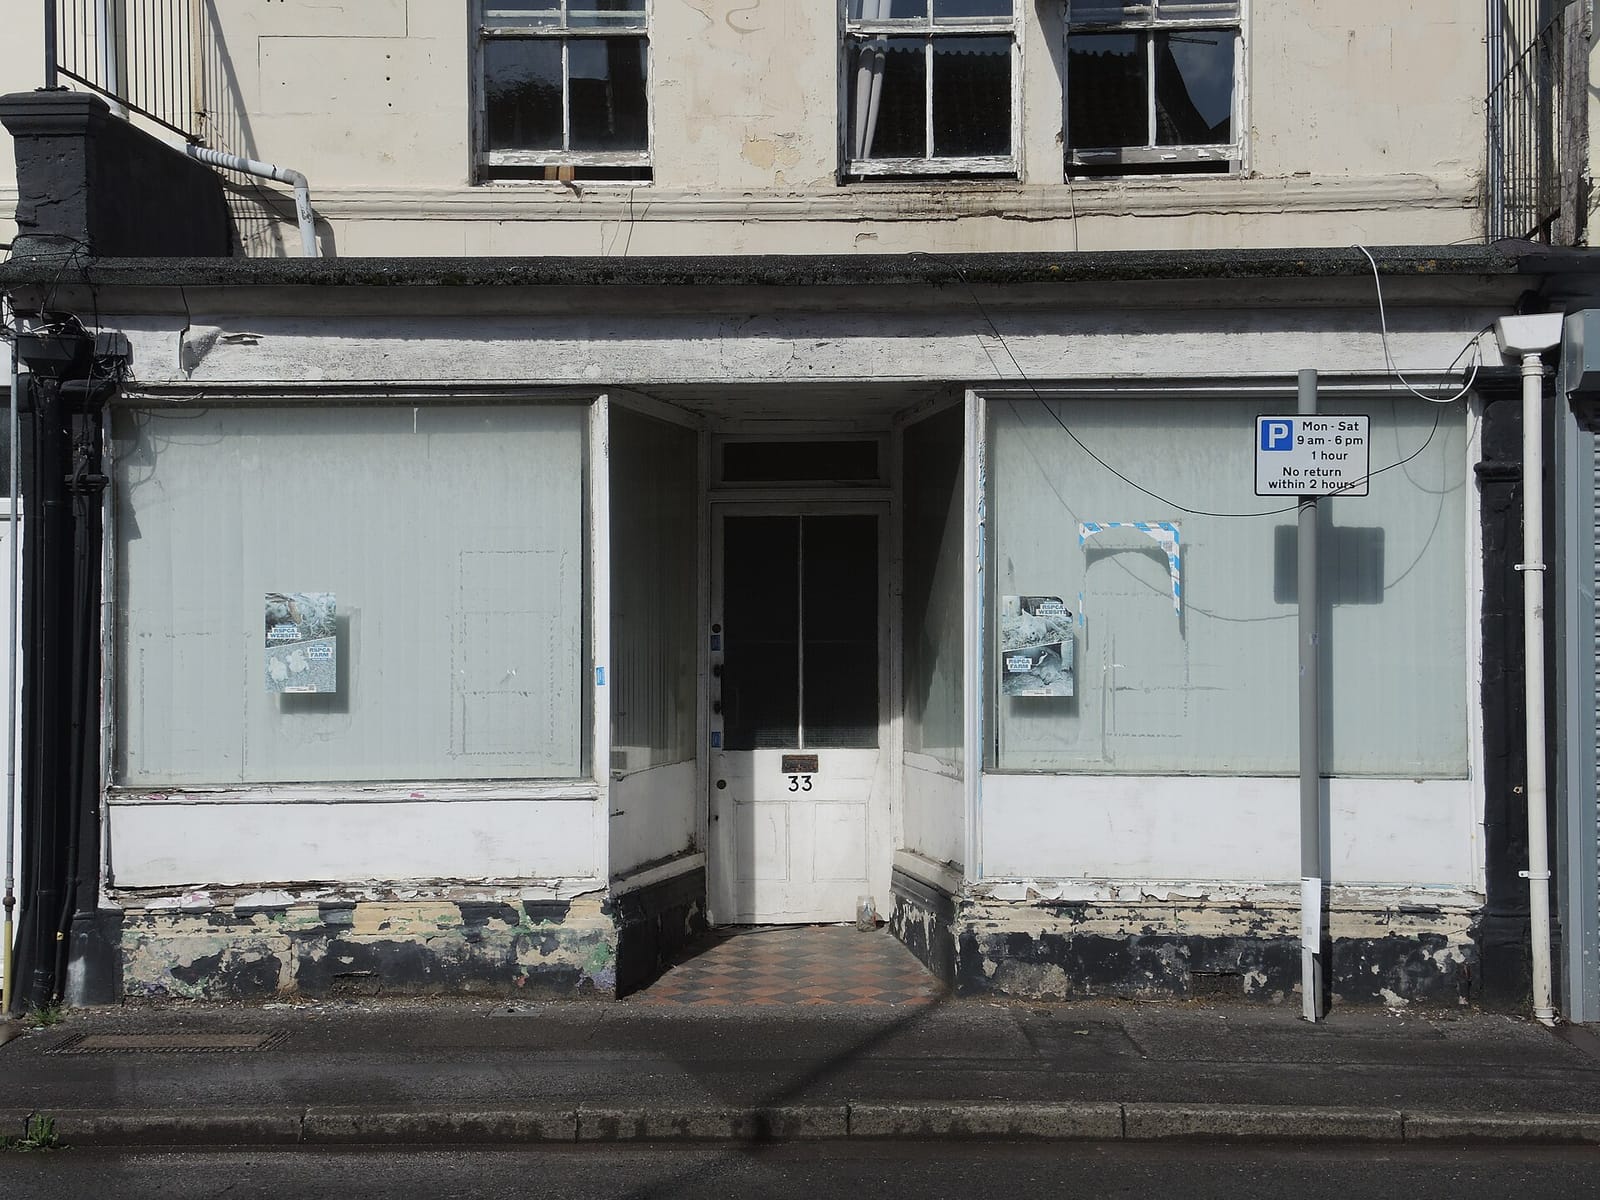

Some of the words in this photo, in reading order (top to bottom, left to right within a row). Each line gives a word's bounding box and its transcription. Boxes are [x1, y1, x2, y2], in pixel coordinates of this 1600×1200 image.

[1302, 421, 1328, 431] Mon
[1337, 421, 1359, 431] Sat
[1269, 423, 1289, 448] P
[1296, 435, 1305, 445] 9
[1307, 437, 1325, 445] am
[1334, 435, 1342, 445] 6
[1345, 437, 1363, 446] pm
[1311, 451, 1316, 460] 1
[1321, 450, 1348, 460] hour
[1282, 467, 1300, 476] No
[1304, 467, 1342, 476] return
[1268, 479, 1305, 489] within
[1309, 479, 1317, 489] 2
[1321, 479, 1355, 489] hours
[787, 775, 813, 792] 33
